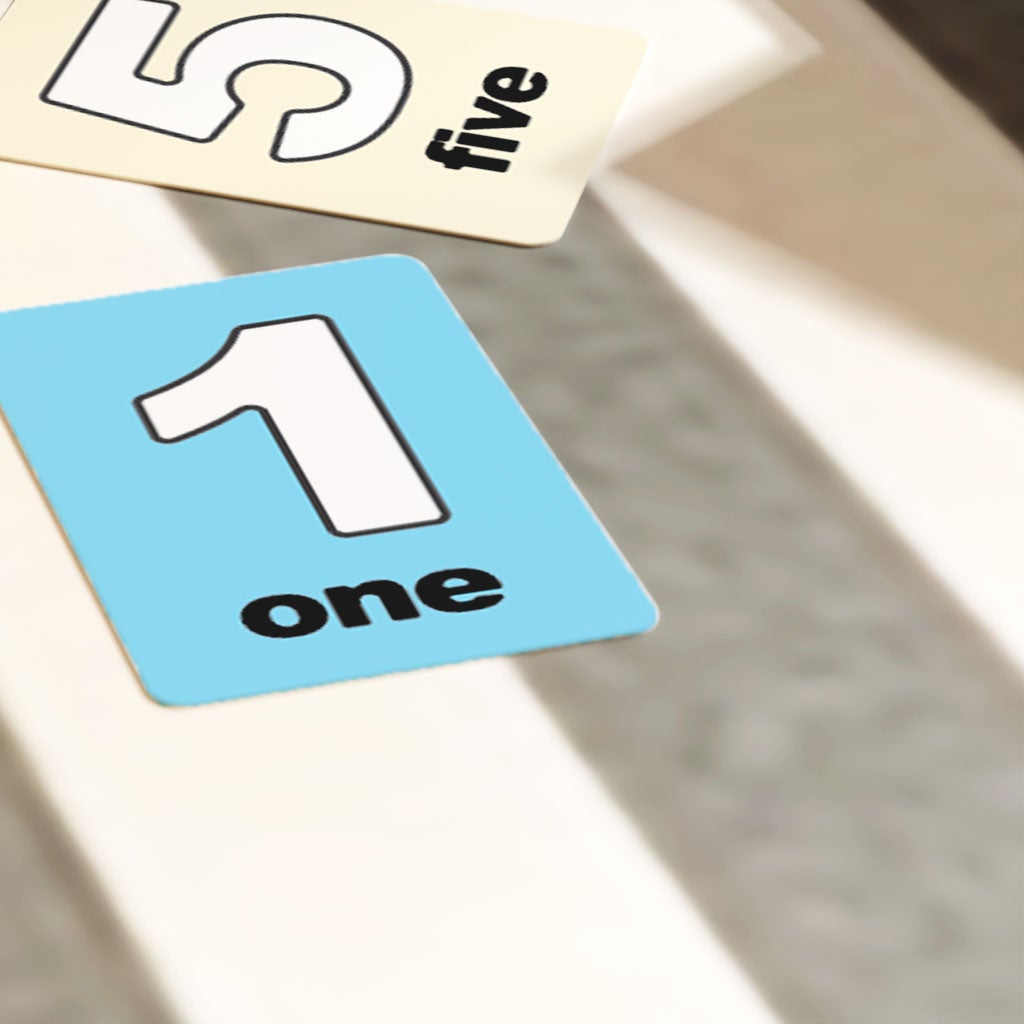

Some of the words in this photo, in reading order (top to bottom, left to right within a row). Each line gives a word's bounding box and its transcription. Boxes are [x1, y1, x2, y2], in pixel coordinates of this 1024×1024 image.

[424, 65, 549, 174] five
[133, 313, 452, 538] 1
[239, 566, 505, 640] one
